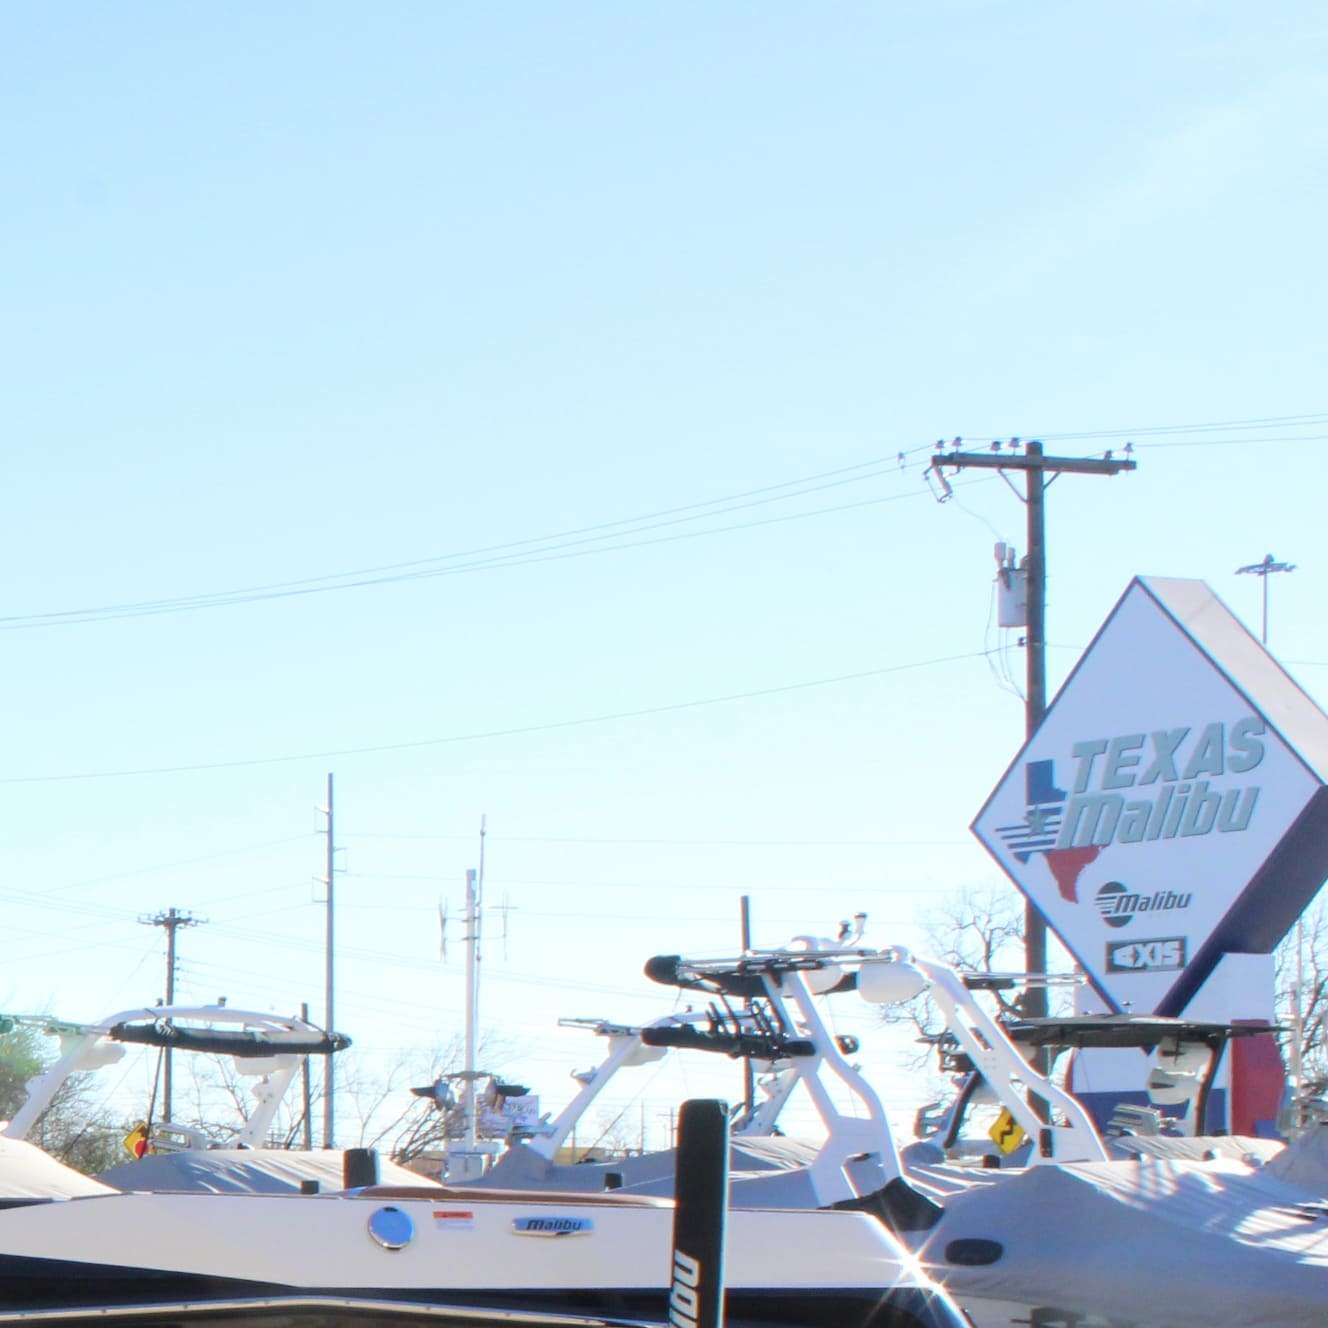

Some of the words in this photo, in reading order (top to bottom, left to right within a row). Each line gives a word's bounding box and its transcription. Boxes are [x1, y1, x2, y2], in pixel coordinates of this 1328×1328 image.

[1071, 716, 1266, 795] TEXAS
[1055, 780, 1261, 849] Malibu
[1113, 890, 1192, 914] Malibu
[526, 1218, 582, 1231] Malibu
